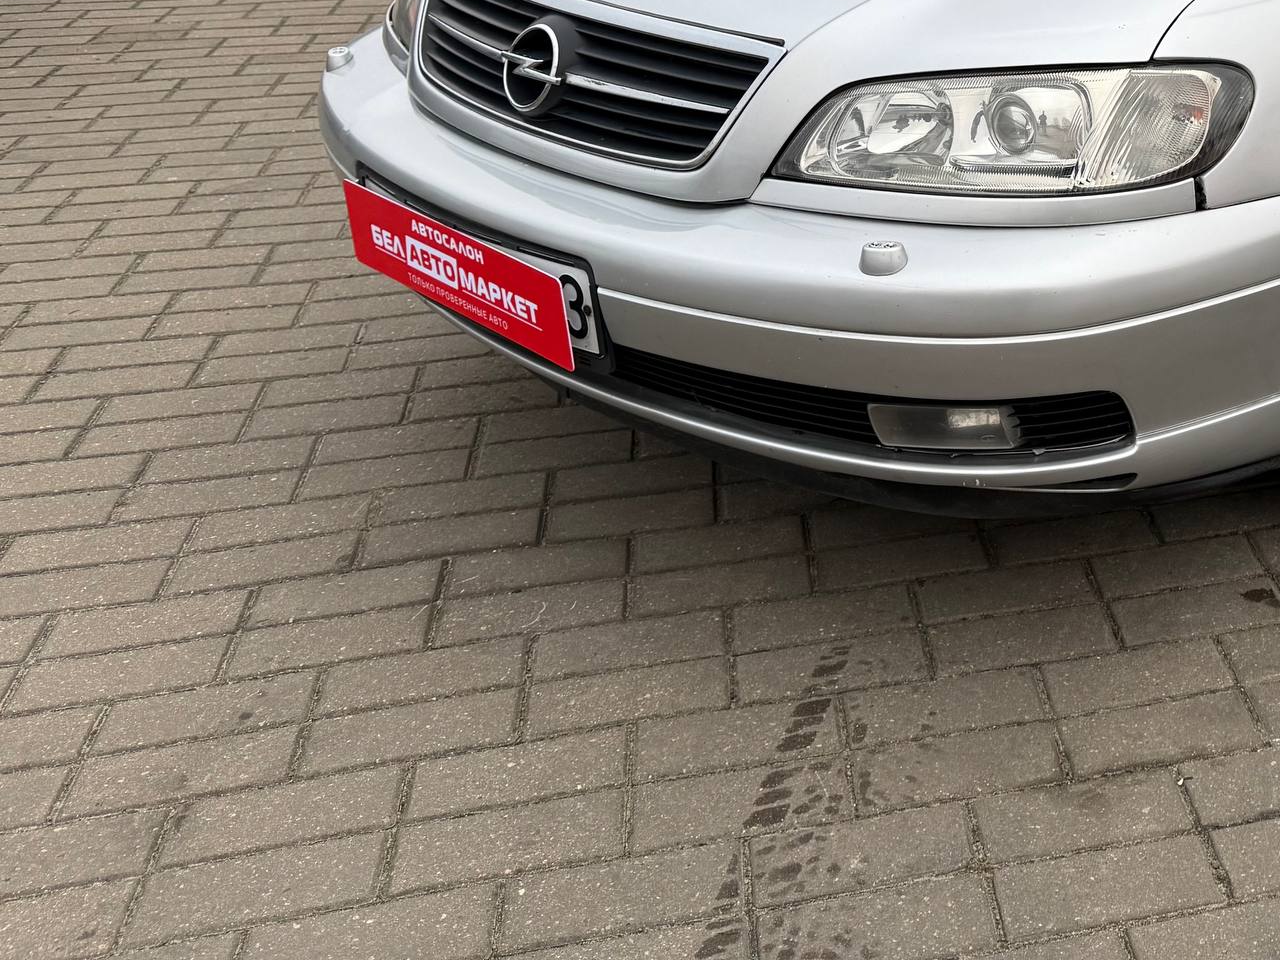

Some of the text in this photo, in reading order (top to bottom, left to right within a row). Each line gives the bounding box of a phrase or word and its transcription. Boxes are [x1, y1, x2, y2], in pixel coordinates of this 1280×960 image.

[411, 219, 484, 265] АВТОСАЛОН
[370, 223, 538, 324] БЕЛ АВТО МАРКЕТ
[408, 272, 508, 330] ТОЛЬКО ПРОВЕРЕННЫЕ АВТО
